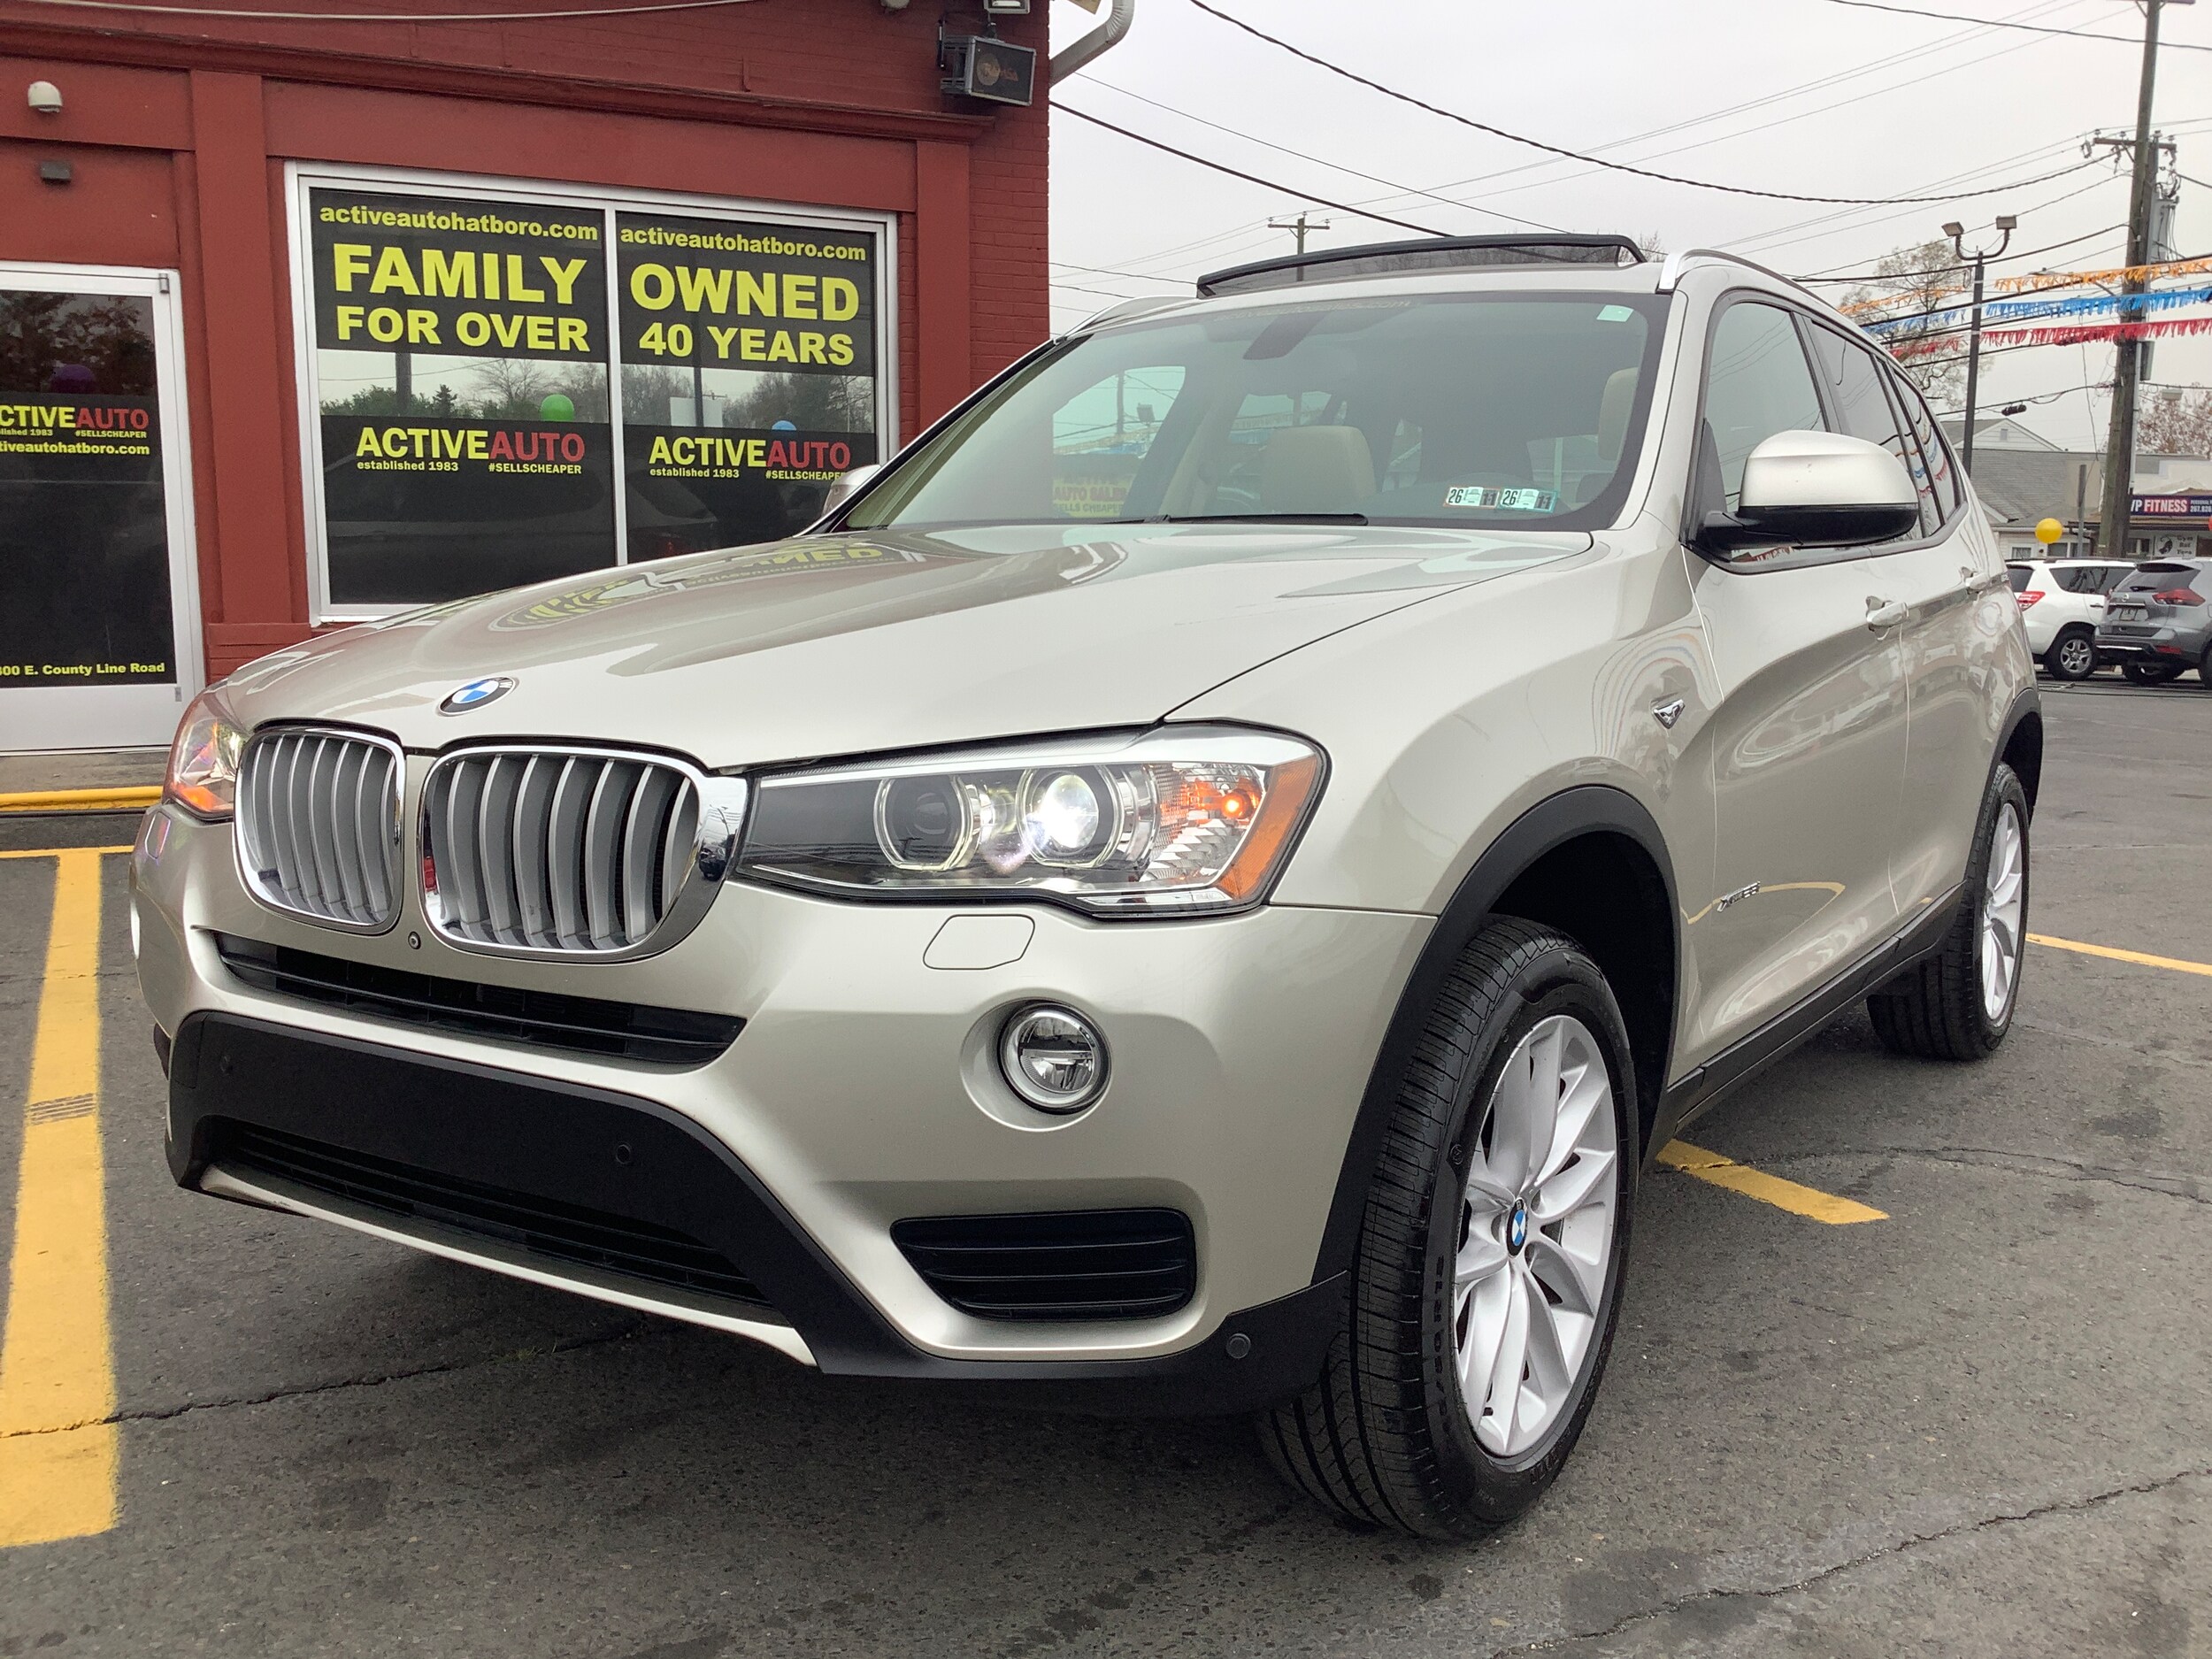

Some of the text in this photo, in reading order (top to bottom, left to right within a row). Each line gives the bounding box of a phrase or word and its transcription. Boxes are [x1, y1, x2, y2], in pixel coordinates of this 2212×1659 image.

[319, 205, 598, 240] activeautohatboro.com
[620, 227, 865, 261] activeautohatboro.com
[334, 243, 588, 304] FAMILY
[630, 263, 859, 322] OWNED
[337, 305, 590, 352] FOR OVER
[639, 322, 854, 366] 40 YEARS
[75, 430, 147, 439] #SELLSCHEAPER
[357, 461, 582, 474] established 1983 #SELLSCHEAPER
[649, 467, 710, 477] established
[712, 468, 740, 479] 1983
[1448, 488, 1464, 504] 26
[1502, 490, 1518, 505] 26
[2144, 499, 2188, 513] FITNESS
[0, 662, 165, 677] 00 E. County Line Road
